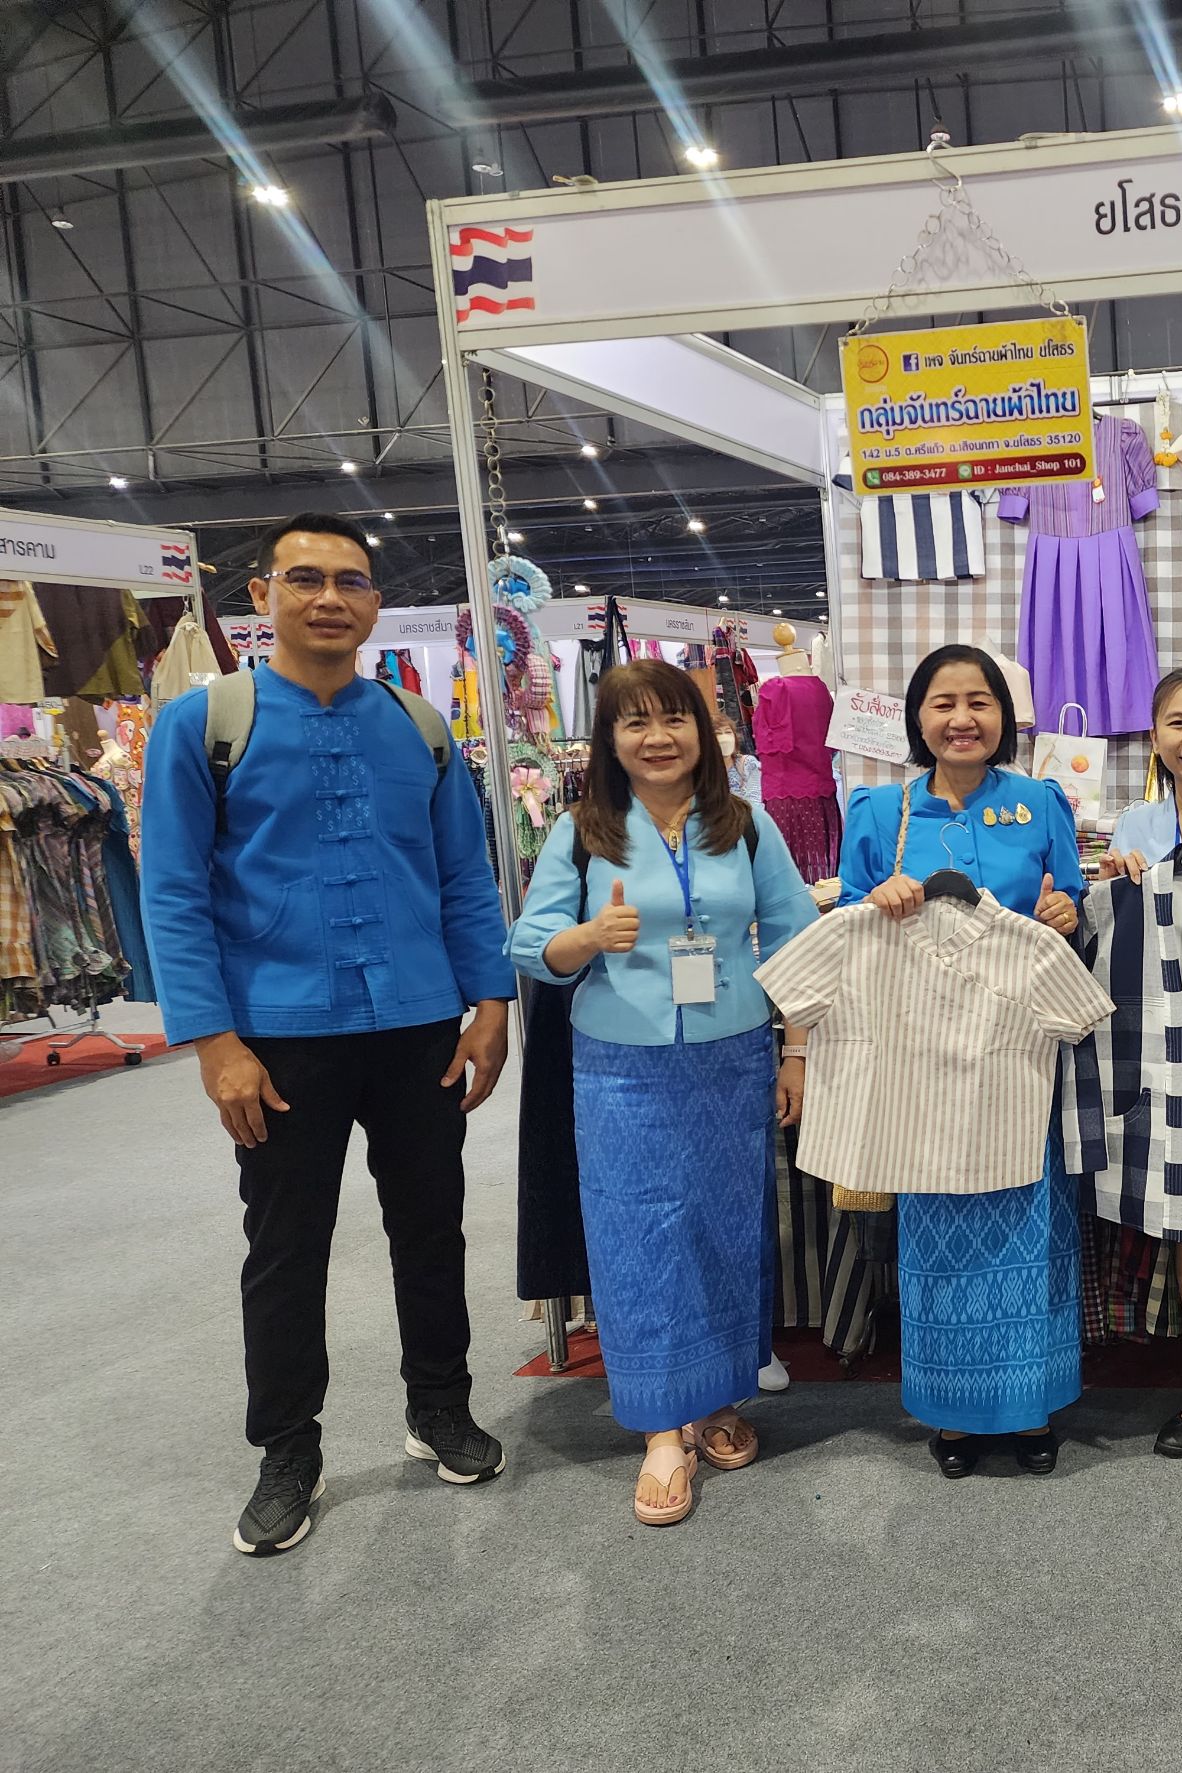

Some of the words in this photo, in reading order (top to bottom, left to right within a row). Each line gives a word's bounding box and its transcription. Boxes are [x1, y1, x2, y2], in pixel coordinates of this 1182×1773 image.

[924, 354, 943, 368] เพจ
[949, 343, 1033, 366] จันทร์ฉายผ้าไทย
[1039, 339, 1074, 358] ยโสธร
[860, 381, 1076, 436] กลุ่มจันทร์ฉายผ้าไทย
[862, 449, 880, 459] 142
[1047, 432, 1080, 445] 35120
[882, 467, 946, 481] 084-389-3477
[974, 465, 984, 475] ID
[1064, 458, 1080, 468] 101
[138, 564, 154, 576] L22
[399, 619, 453, 634] นครราชสีมา
